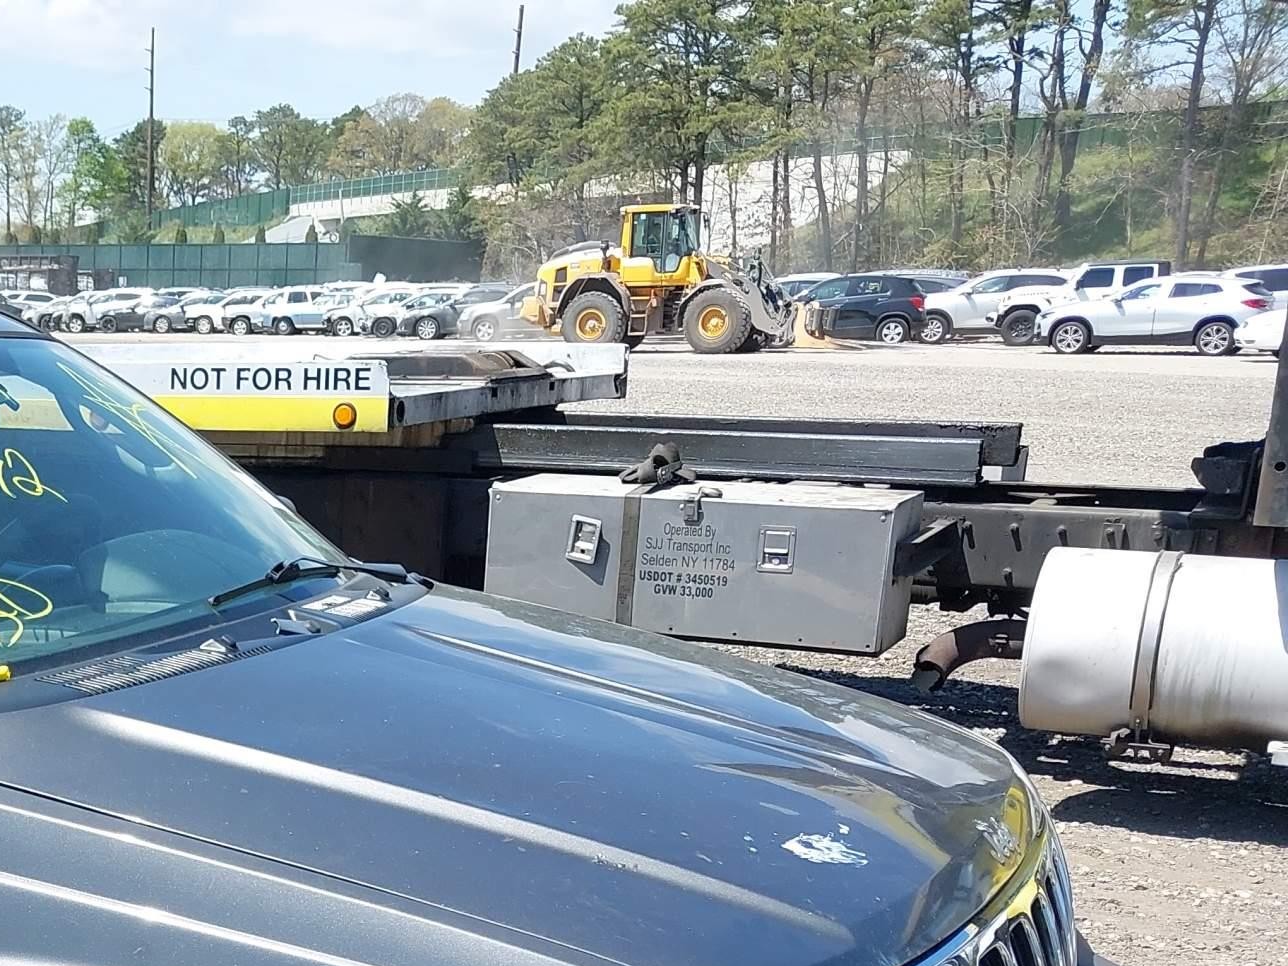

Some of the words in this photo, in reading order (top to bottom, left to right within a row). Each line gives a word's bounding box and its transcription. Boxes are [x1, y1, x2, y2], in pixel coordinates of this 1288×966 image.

[169, 366, 227, 391] NOT
[235, 366, 293, 391] FOR
[302, 366, 372, 391] HIRE
[663, 522, 703, 538] Operated
[705, 525, 717, 540] By
[645, 536, 664, 550] SJJ
[666, 538, 713, 554] Transport
[715, 541, 732, 555] Inc
[640, 553, 678, 567] Selden
[681, 556, 699, 569] NY
[702, 557, 736, 571] 11784
[639, 569, 674, 583] USDOT
[676, 572, 683, 583] #
[685, 573, 728, 587] 3450519
[653, 583, 678, 595] GVW
[679, 585, 714, 600] 33,000
